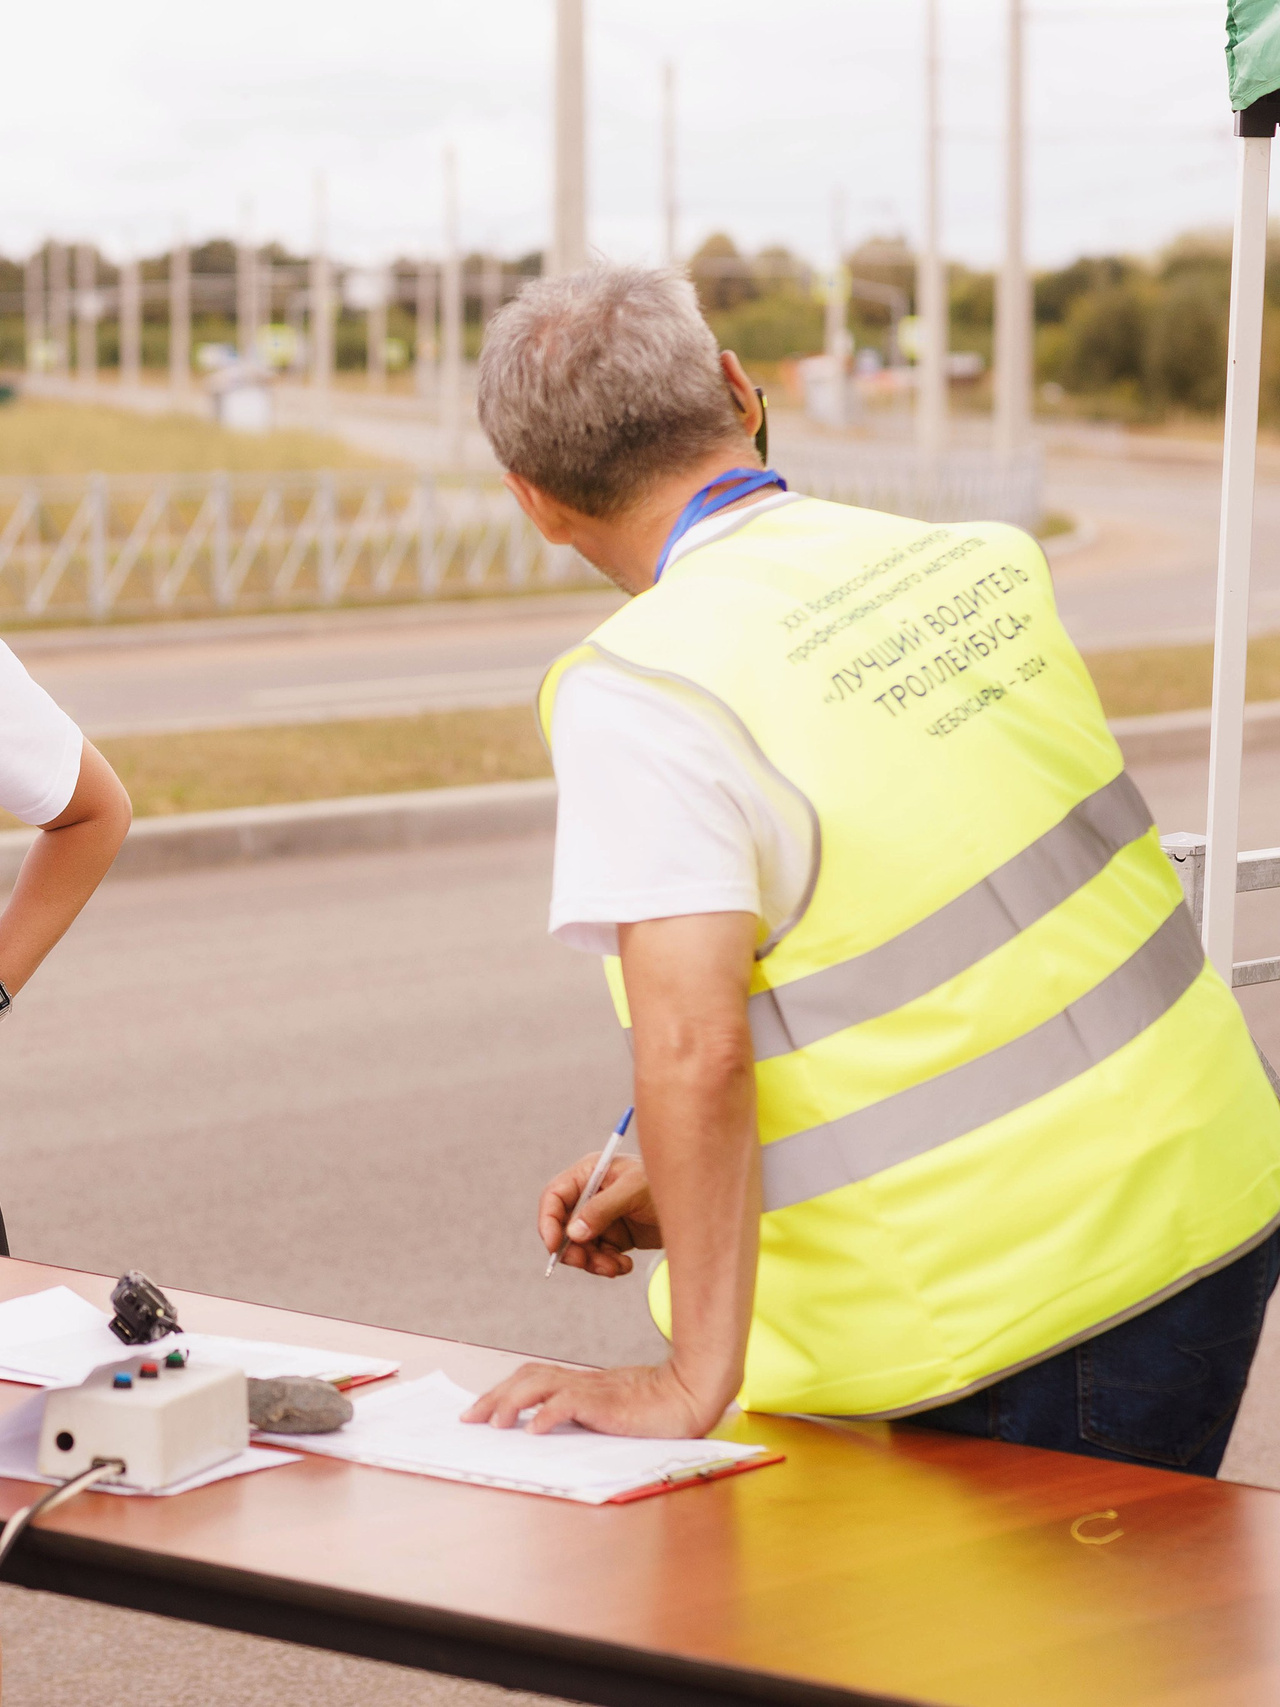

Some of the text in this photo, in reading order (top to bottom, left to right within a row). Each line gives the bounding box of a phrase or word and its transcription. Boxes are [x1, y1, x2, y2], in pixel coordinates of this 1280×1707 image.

[823, 564, 1030, 704] «ЛУЧШИЙ ВОДИТЕЛЬ
[873, 611, 1032, 718] ТРОЛЛЕЙБУСА»
[926, 680, 1007, 737] ЧЕБОКСАРЫ
[1016, 655, 1047, 682] 2024
